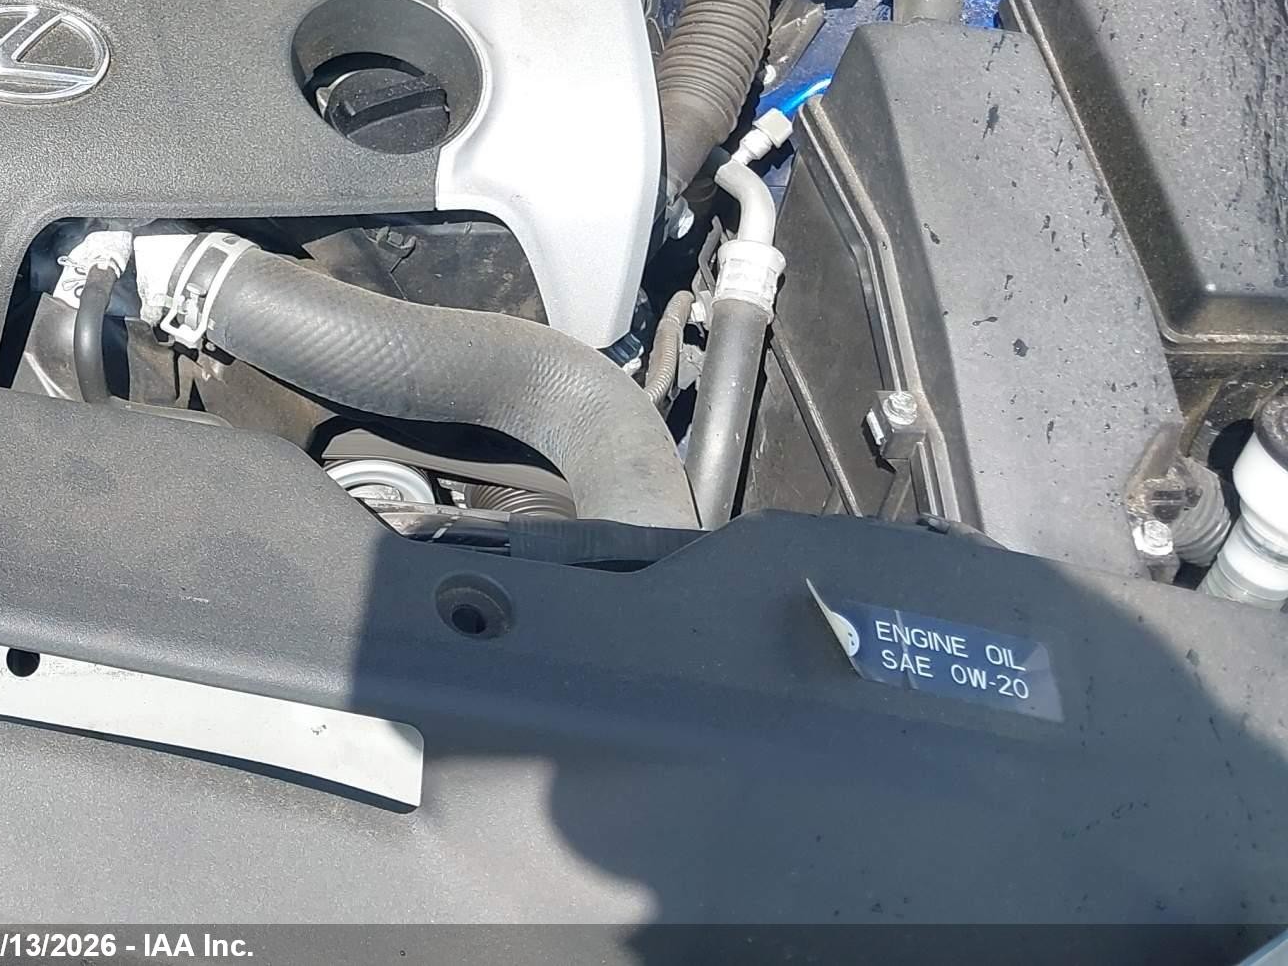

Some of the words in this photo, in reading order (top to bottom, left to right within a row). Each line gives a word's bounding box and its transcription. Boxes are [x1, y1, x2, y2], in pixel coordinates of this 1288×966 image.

[875, 620, 969, 659] ENGINE
[985, 645, 1027, 672] OIL
[881, 649, 934, 679] SAE
[950, 664, 1030, 700] 0W-20
